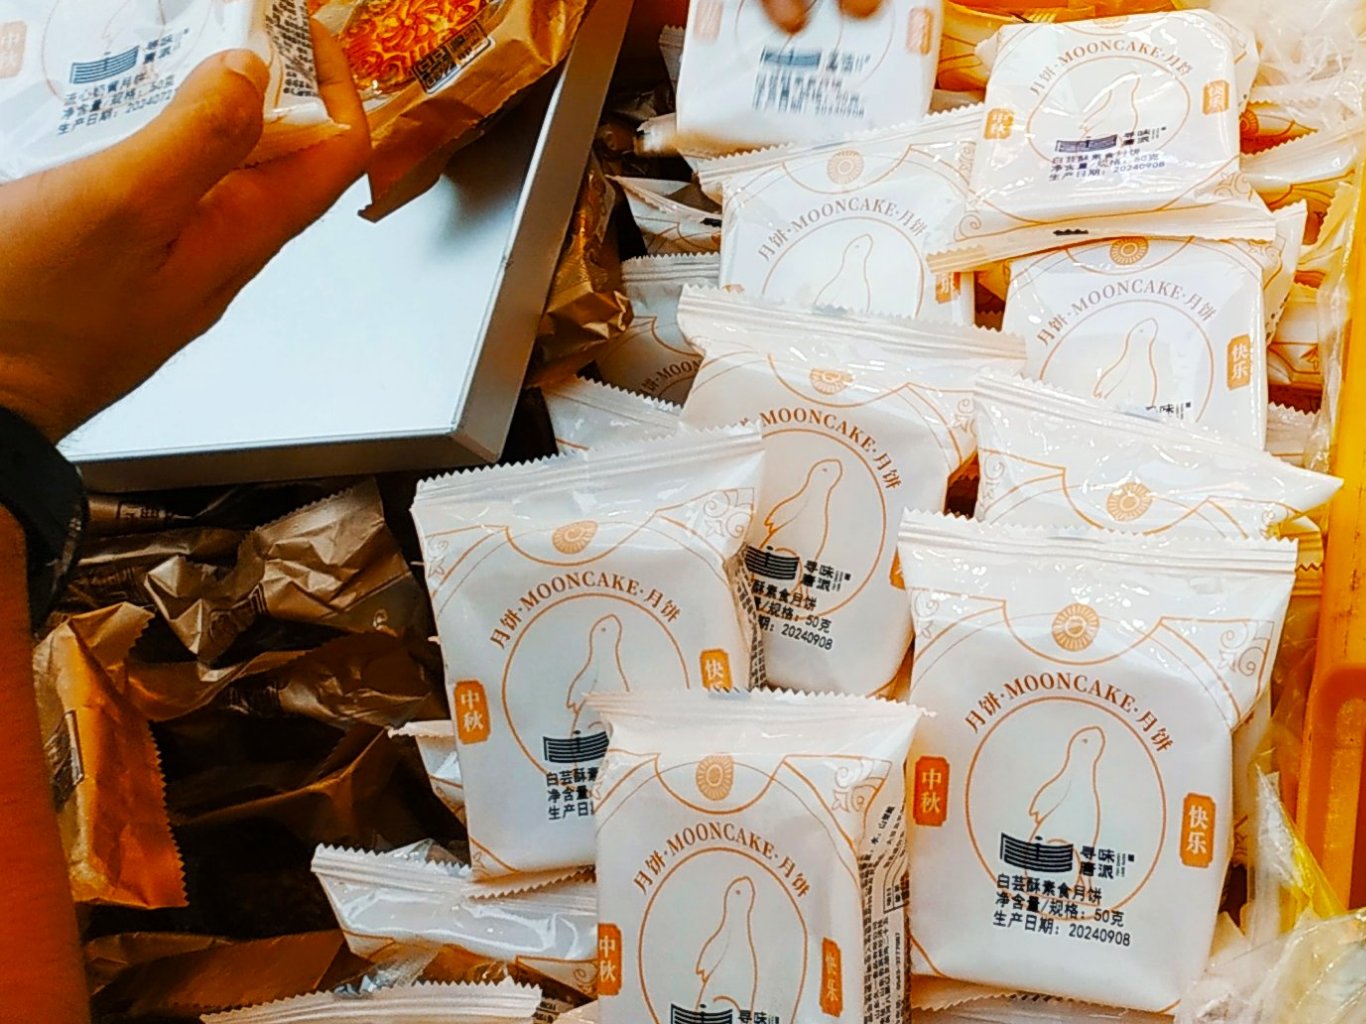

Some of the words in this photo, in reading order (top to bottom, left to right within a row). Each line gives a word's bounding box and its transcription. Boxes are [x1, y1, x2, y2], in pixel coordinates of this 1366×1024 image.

[758, 197, 928, 263] 月饼·MOONCAKE·月饼
[1036, 279, 1217, 347] 月饼·MOONCAKE·月饼
[1231, 342, 1252, 381] 快乐
[490, 571, 682, 650] 月饼·MOONCAKE·月饼
[460, 689, 485, 733] 中秋
[964, 670, 1176, 755] 月饼·MOONCAKE·月饼
[548, 800, 595, 821] 生产日
[919, 767, 942, 816] 中秋
[1080, 844, 1116, 864] 寻味
[1187, 804, 1208, 856] 快乐
[633, 822, 813, 897] 月饼·MOONCAKE·月饼
[996, 873, 1103, 904] 白芸酥素食月饼
[992, 910, 1132, 947] 生产日期：20240908
[598, 935, 617, 982] 中秋
[824, 953, 840, 1003] 快乐
